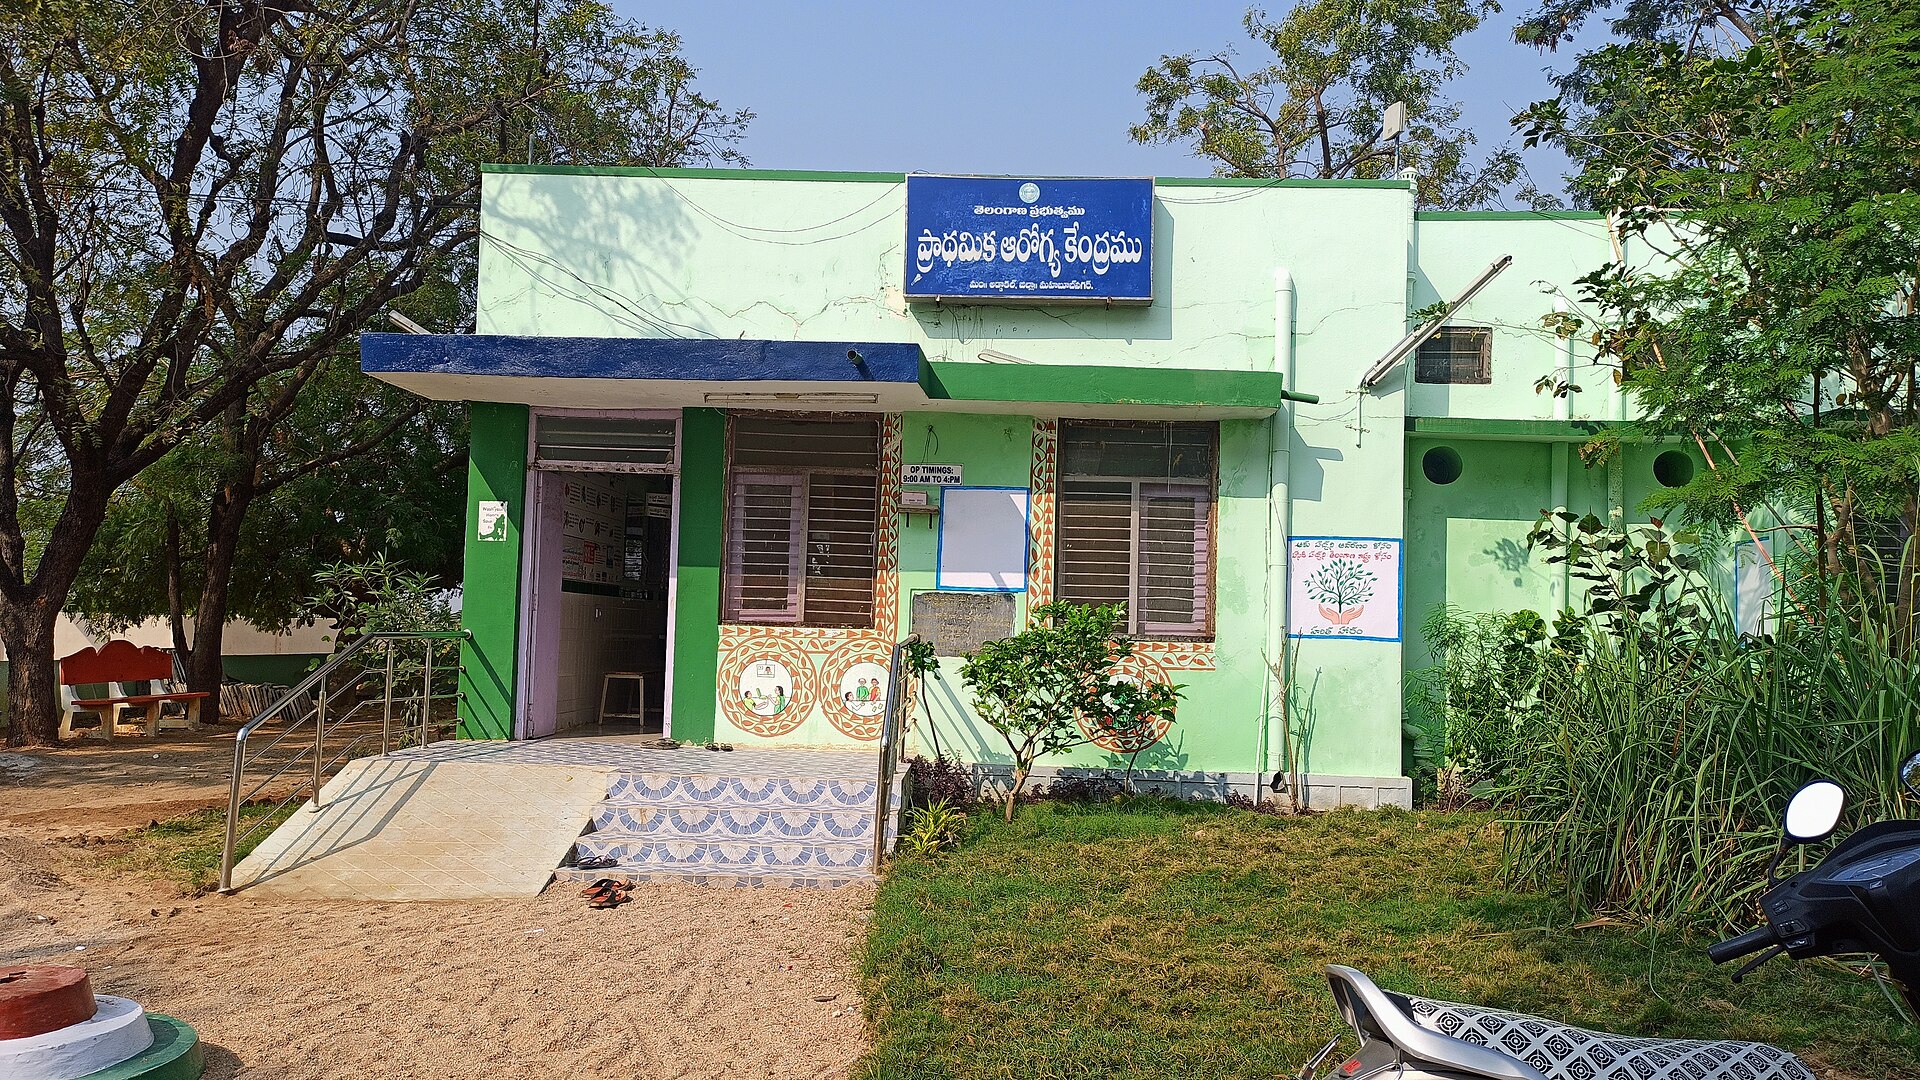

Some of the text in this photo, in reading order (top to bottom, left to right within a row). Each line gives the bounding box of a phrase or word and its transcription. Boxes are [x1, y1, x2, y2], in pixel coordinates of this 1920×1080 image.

[973, 205, 1086, 219] తెలంగాణ ప్రభుత్వము
[1000, 222, 1062, 278] ఆరోగ్య
[1063, 221, 1142, 275] కేంద్రము
[922, 466, 953, 474] TIMINGS:
